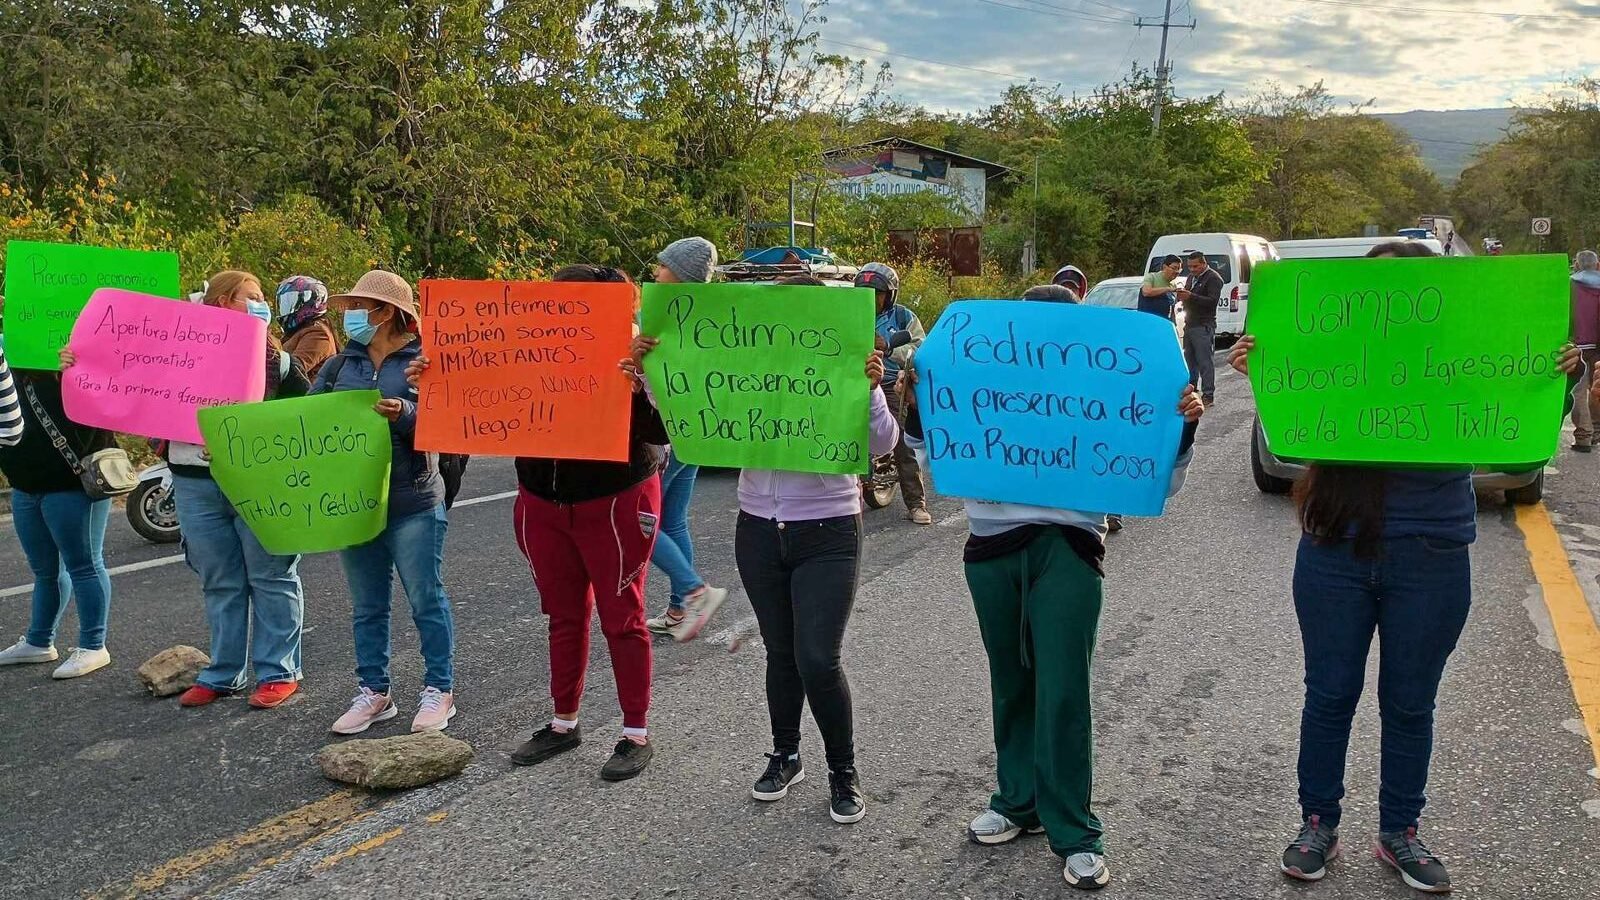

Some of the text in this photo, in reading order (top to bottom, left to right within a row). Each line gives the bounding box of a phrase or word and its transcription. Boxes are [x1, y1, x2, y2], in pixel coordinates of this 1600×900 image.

[26, 252, 88, 287] Recurso
[18, 306, 37, 322] del
[424, 285, 591, 318] Los enfermeros
[1295, 270, 1442, 337] Campo
[94, 305, 229, 343] Apertura laboral
[432, 320, 596, 347] también somos
[667, 294, 842, 357] Pedimos
[941, 311, 1143, 375] Pedimos
[114, 349, 203, 370] "prometida"
[1260, 334, 1562, 393] laboral a Egresados
[75, 373, 101, 392] Para
[107, 376, 119, 393] la
[125, 384, 170, 400] primera
[425, 374, 600, 411] El recurso NUNCA
[663, 362, 832, 408] la presencia
[927, 369, 1155, 426] la presencia de
[664, 411, 692, 438] de
[747, 406, 816, 448] Raquel
[1358, 403, 1431, 442] UBBJ
[1448, 400, 1520, 441] Tixtla
[218, 415, 376, 468] Resolución
[808, 433, 861, 462] Sosa
[927, 427, 1156, 479] Dra Raquel Sosa
[285, 466, 311, 487] de
[303, 502, 312, 527] y
[320, 490, 378, 517] Cédula
